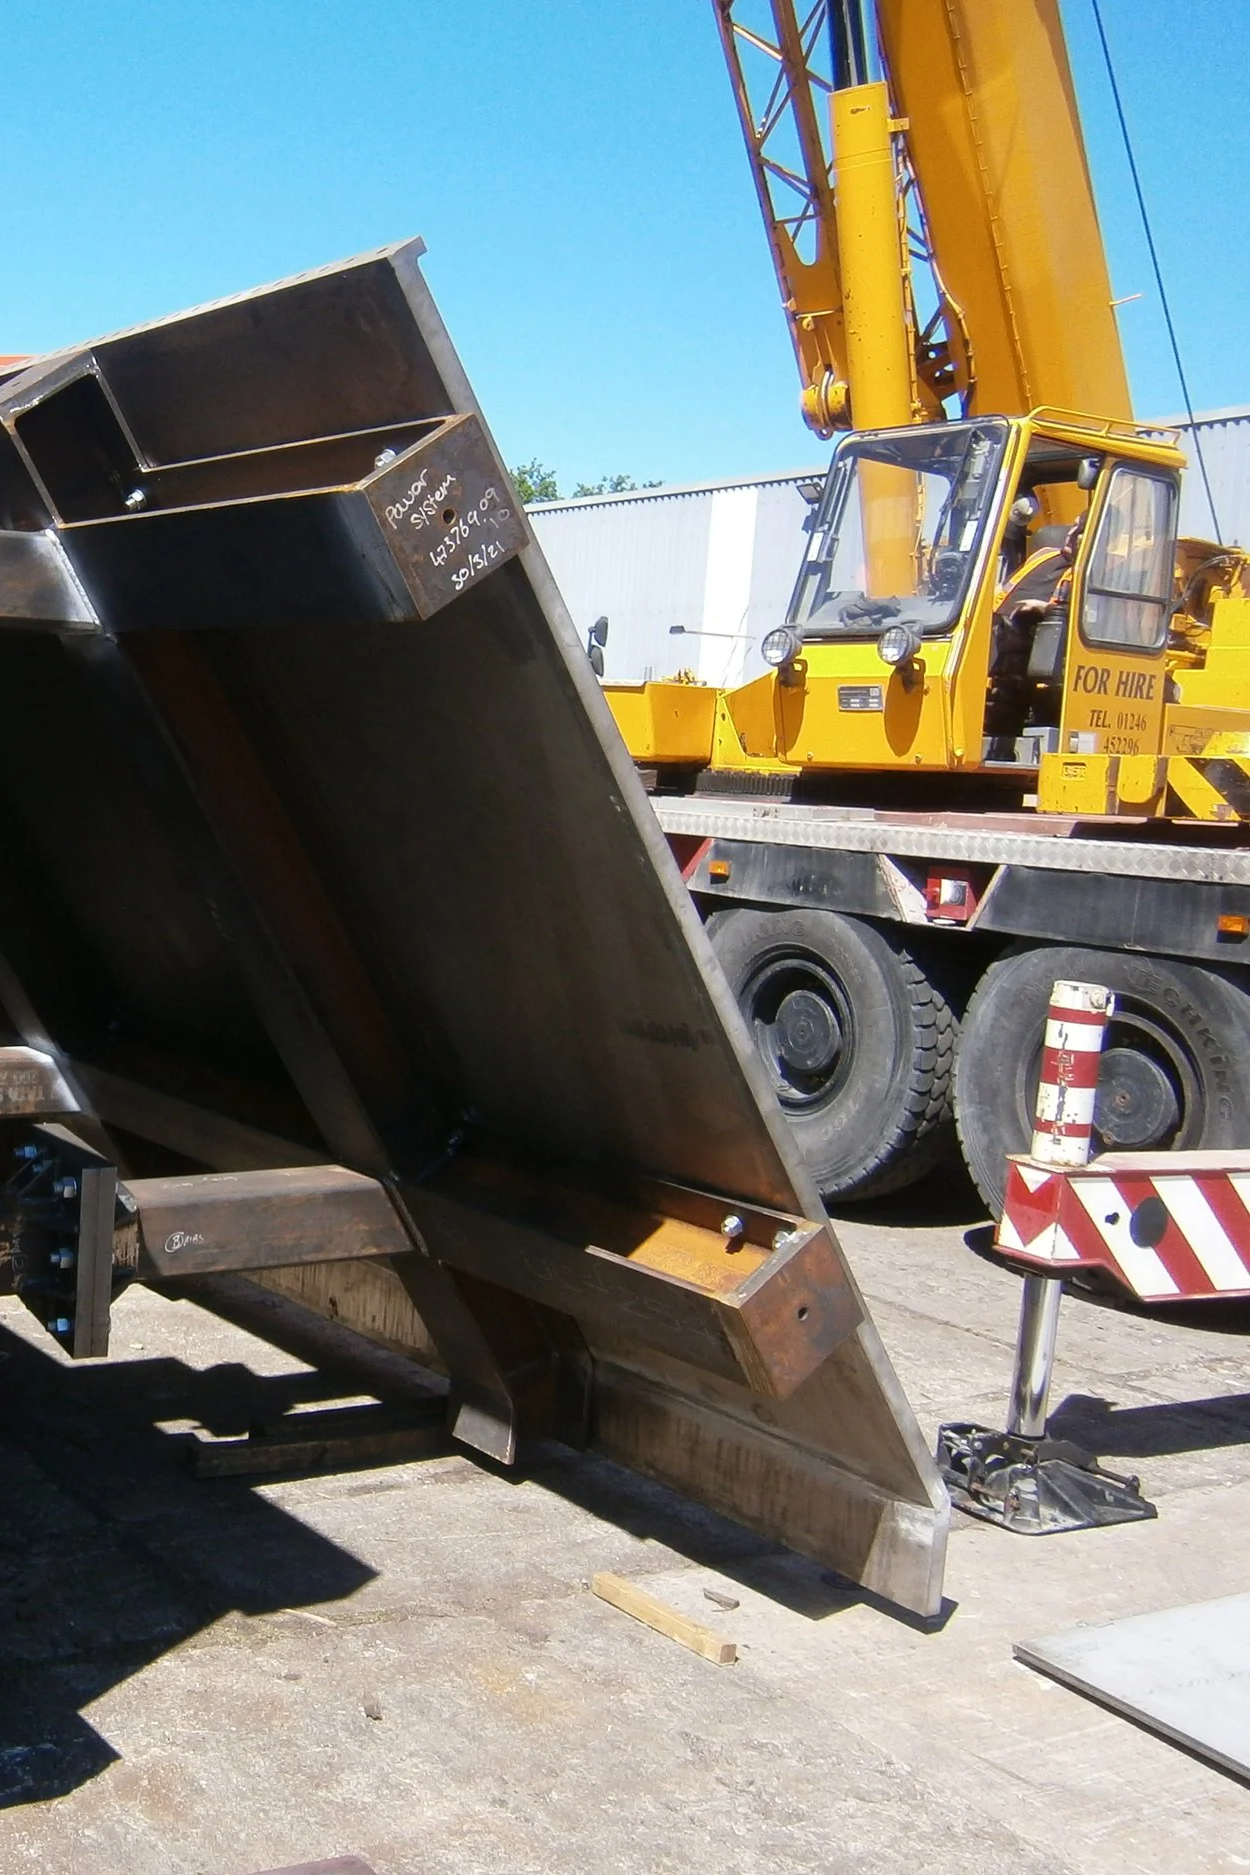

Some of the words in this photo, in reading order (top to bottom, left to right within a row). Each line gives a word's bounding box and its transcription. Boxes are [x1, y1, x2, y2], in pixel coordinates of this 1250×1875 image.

[1072, 664, 1111, 696] FOR
[1114, 669, 1157, 701] HIRE
[1089, 708, 1111, 729] TEL.
[1116, 711, 1147, 732] 01246
